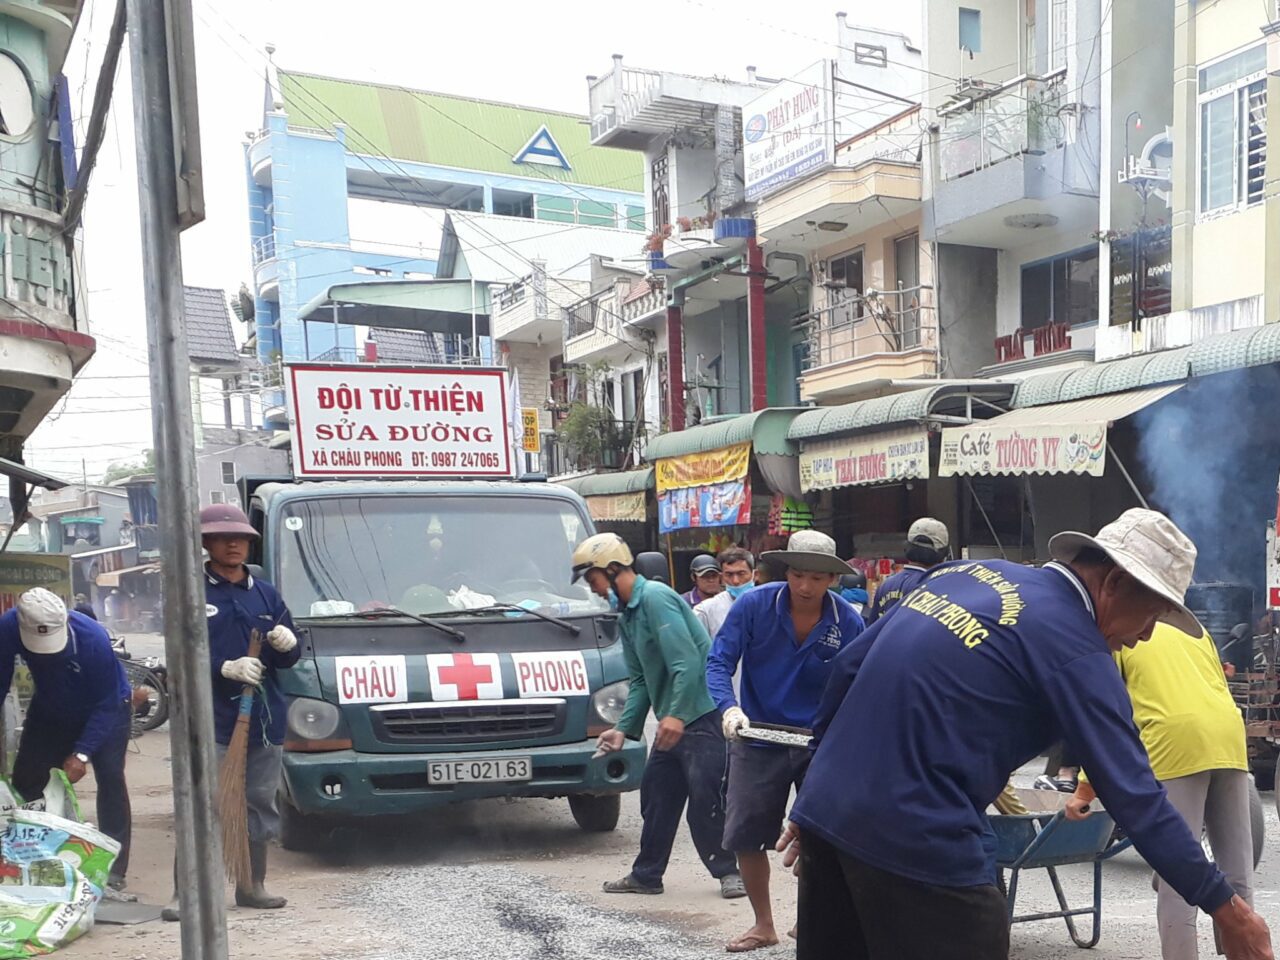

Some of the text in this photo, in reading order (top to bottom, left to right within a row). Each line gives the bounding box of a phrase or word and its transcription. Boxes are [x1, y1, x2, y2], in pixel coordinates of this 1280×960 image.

[317, 383, 362, 415] ĐỘI
[369, 383, 402, 411] TỪ
[315, 418, 493, 443] SỬA ĐƯỜNG
[312, 447, 328, 467] XÃ
[331, 447, 361, 467] CHÂU
[365, 450, 402, 468] PHONG
[431, 452, 457, 468] 0987
[460, 452, 499, 468] 247065
[960, 432, 992, 457] Café
[995, 430, 1037, 468] TƯỜNG
[1041, 437, 1061, 467] VY
[998, 592, 1026, 625] ĐƯỜNG
[934, 603, 989, 649] PHONG
[341, 659, 586, 700] CHÂU PHONG
